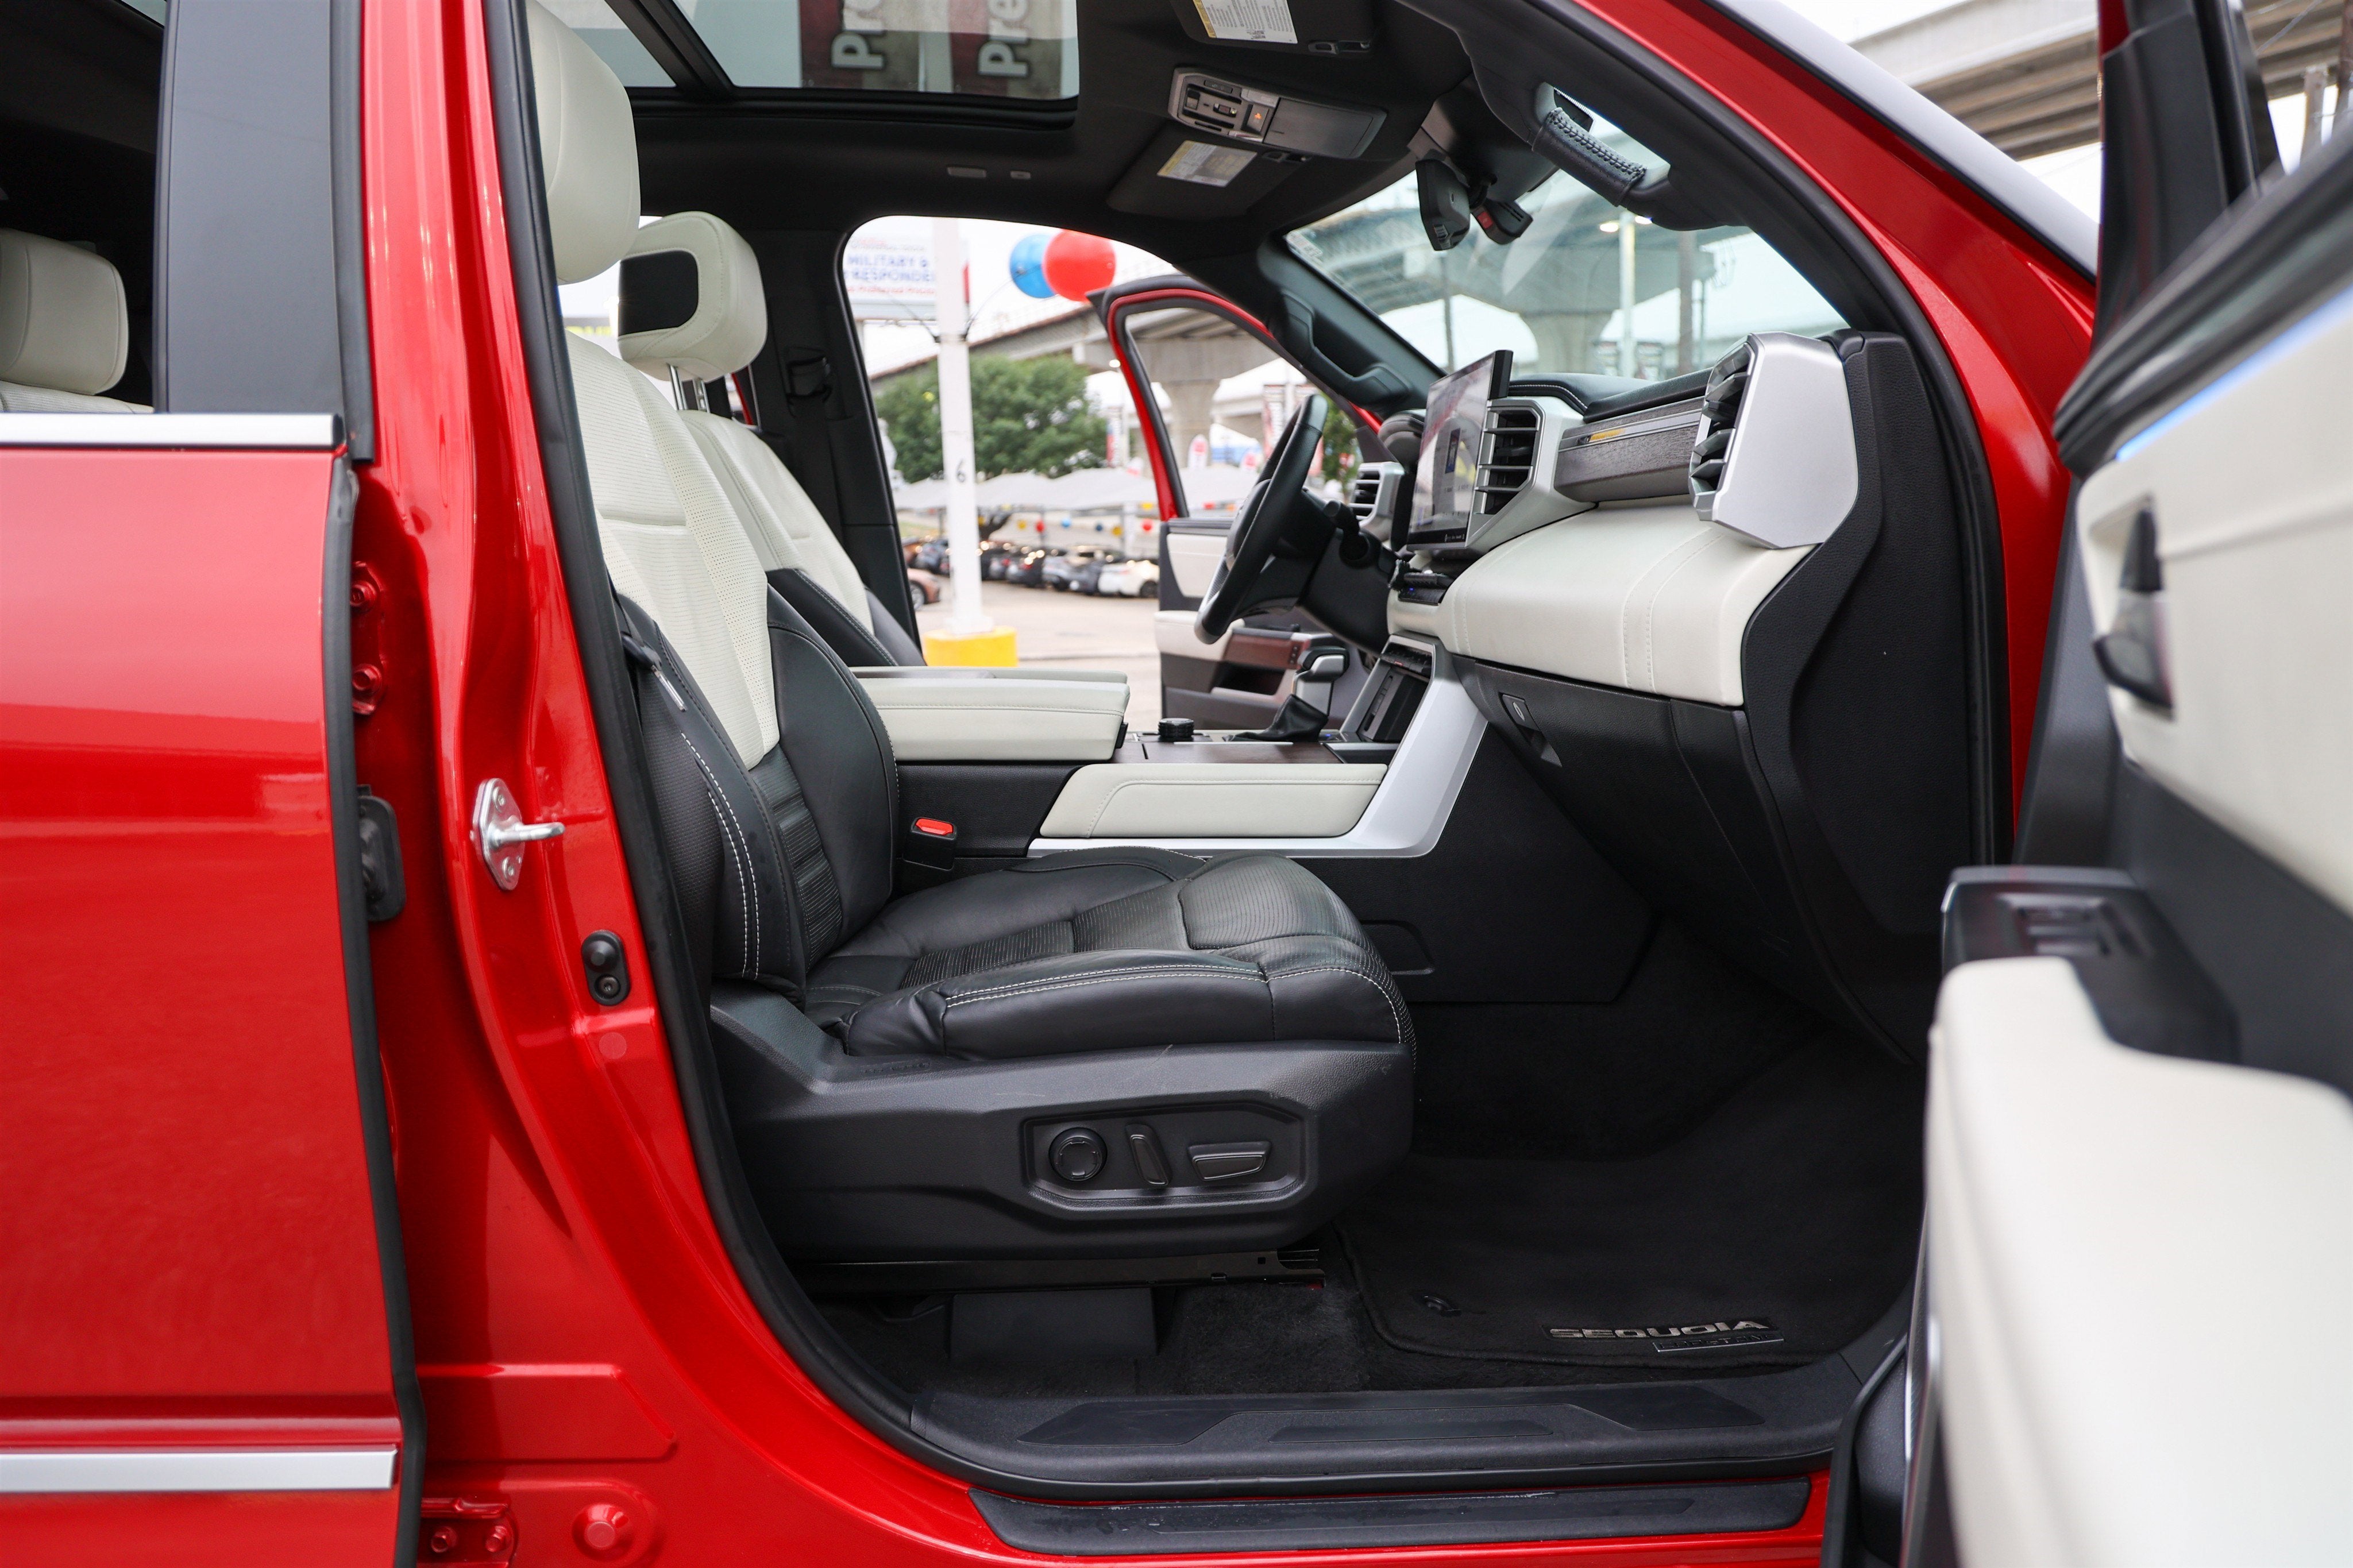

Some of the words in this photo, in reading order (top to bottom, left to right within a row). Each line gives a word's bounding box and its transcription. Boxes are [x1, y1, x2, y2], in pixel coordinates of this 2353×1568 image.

[847, 253, 915, 267] MILITARY
[955, 458, 966, 483] 6
[1550, 1320, 1770, 1338] SEQUOIA
